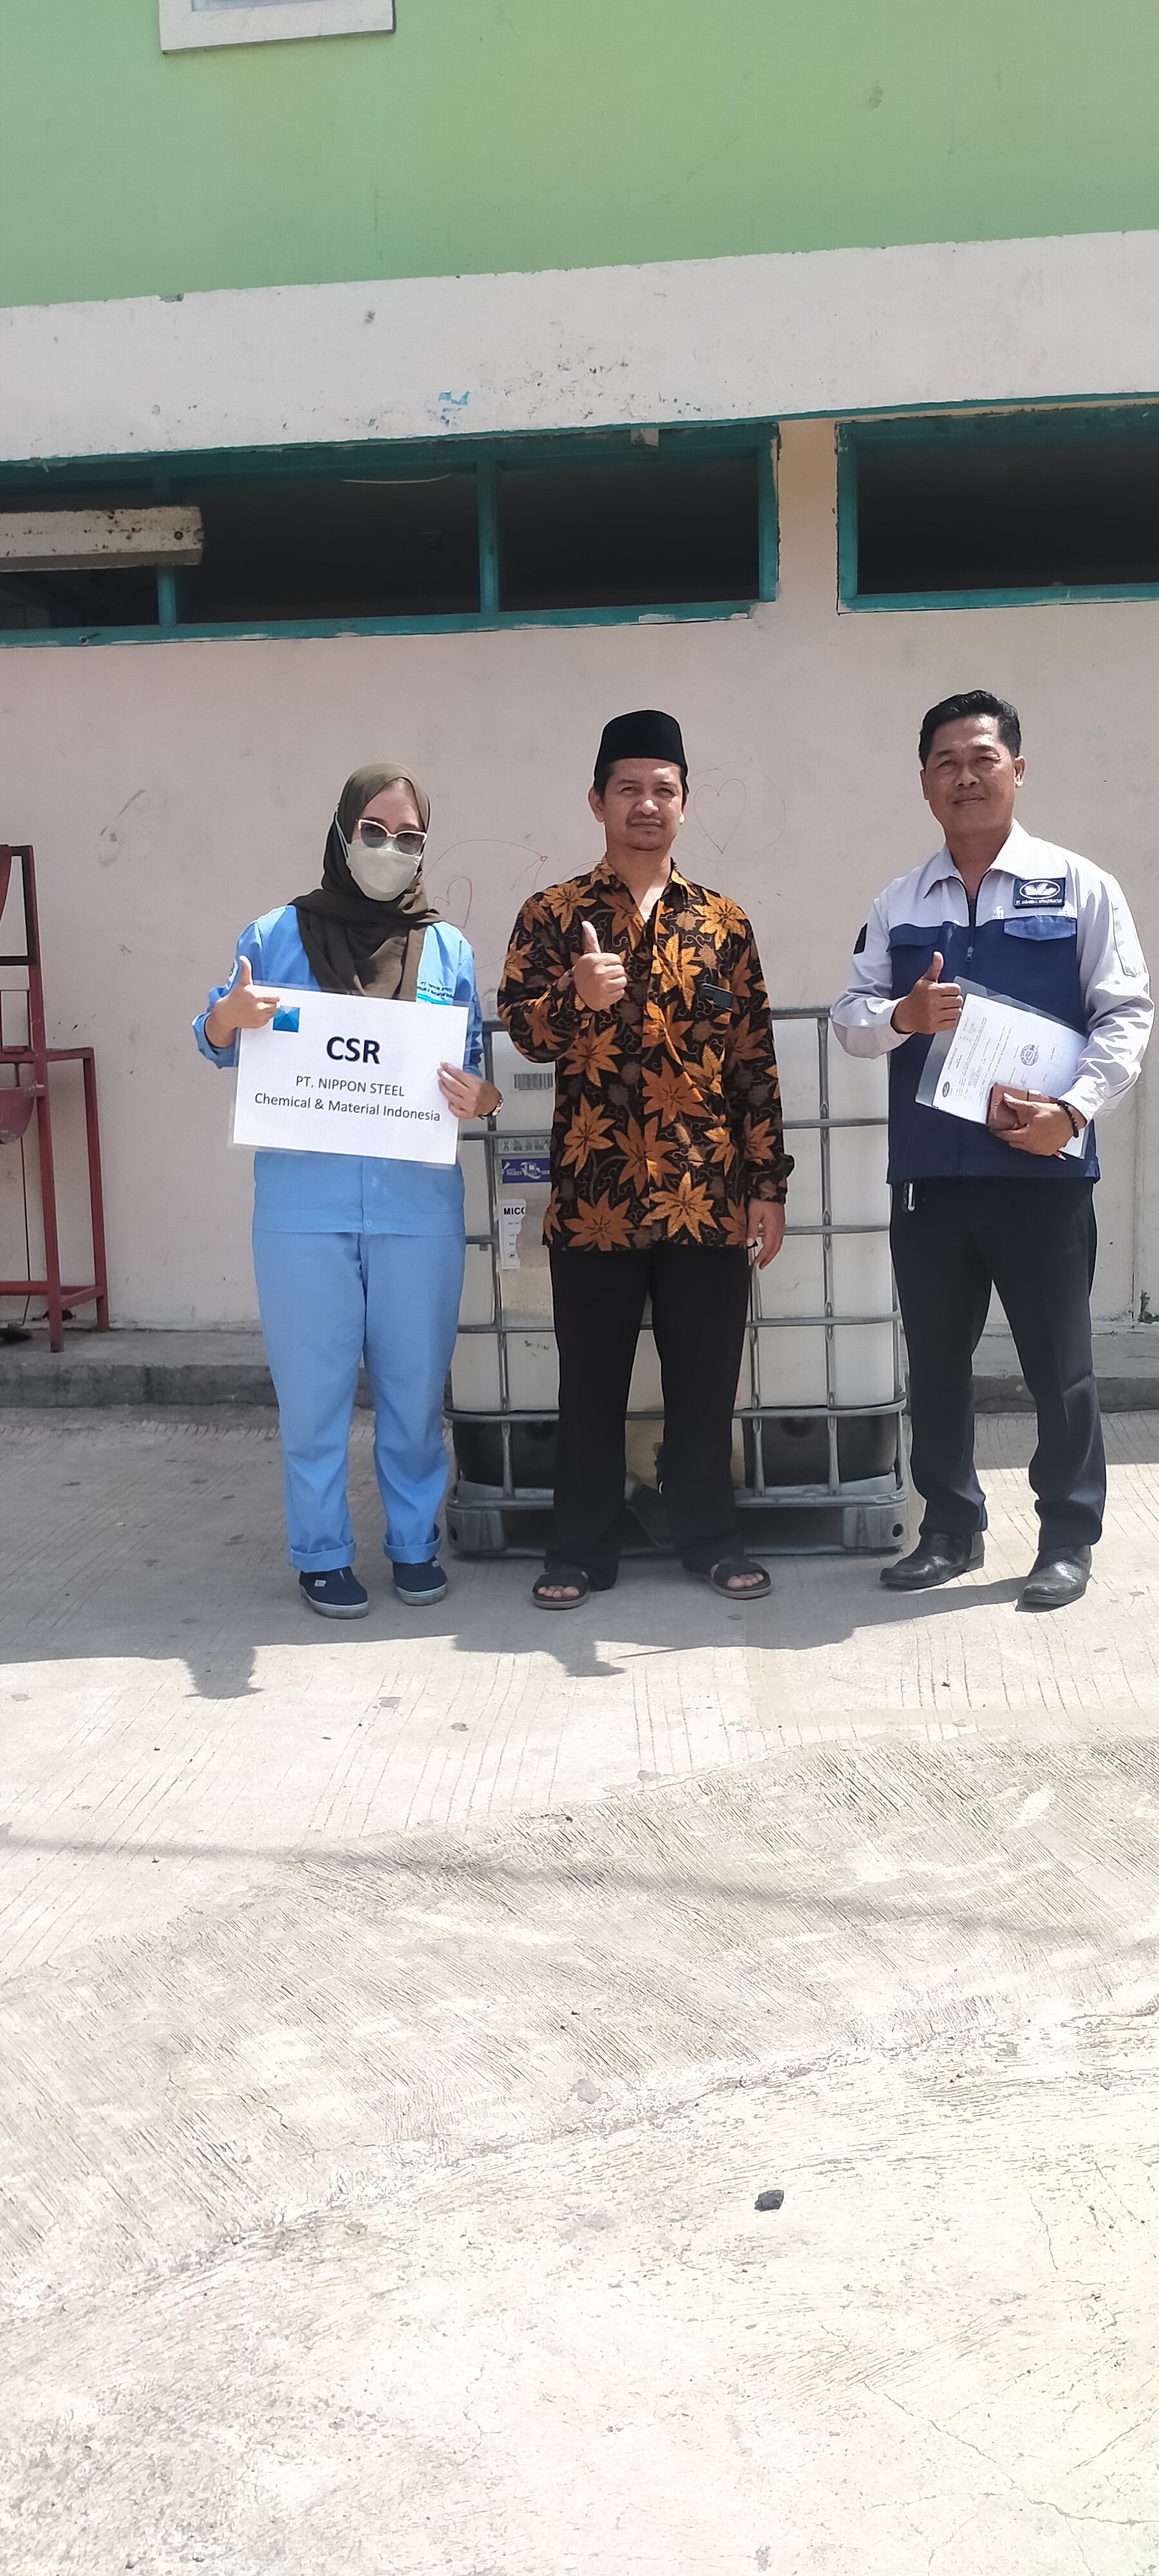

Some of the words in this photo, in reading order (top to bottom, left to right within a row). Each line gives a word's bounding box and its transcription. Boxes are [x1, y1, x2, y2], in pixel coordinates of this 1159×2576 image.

[326, 1036, 380, 1064] CSR
[296, 1075, 314, 1087] PT.
[319, 1078, 366, 1092] NIPPON
[370, 1083, 404, 1096] STEEL
[255, 1093, 310, 1108] Chemical
[315, 1099, 324, 1109] &
[329, 1101, 379, 1115] Material
[383, 1106, 440, 1121] Indonesia
